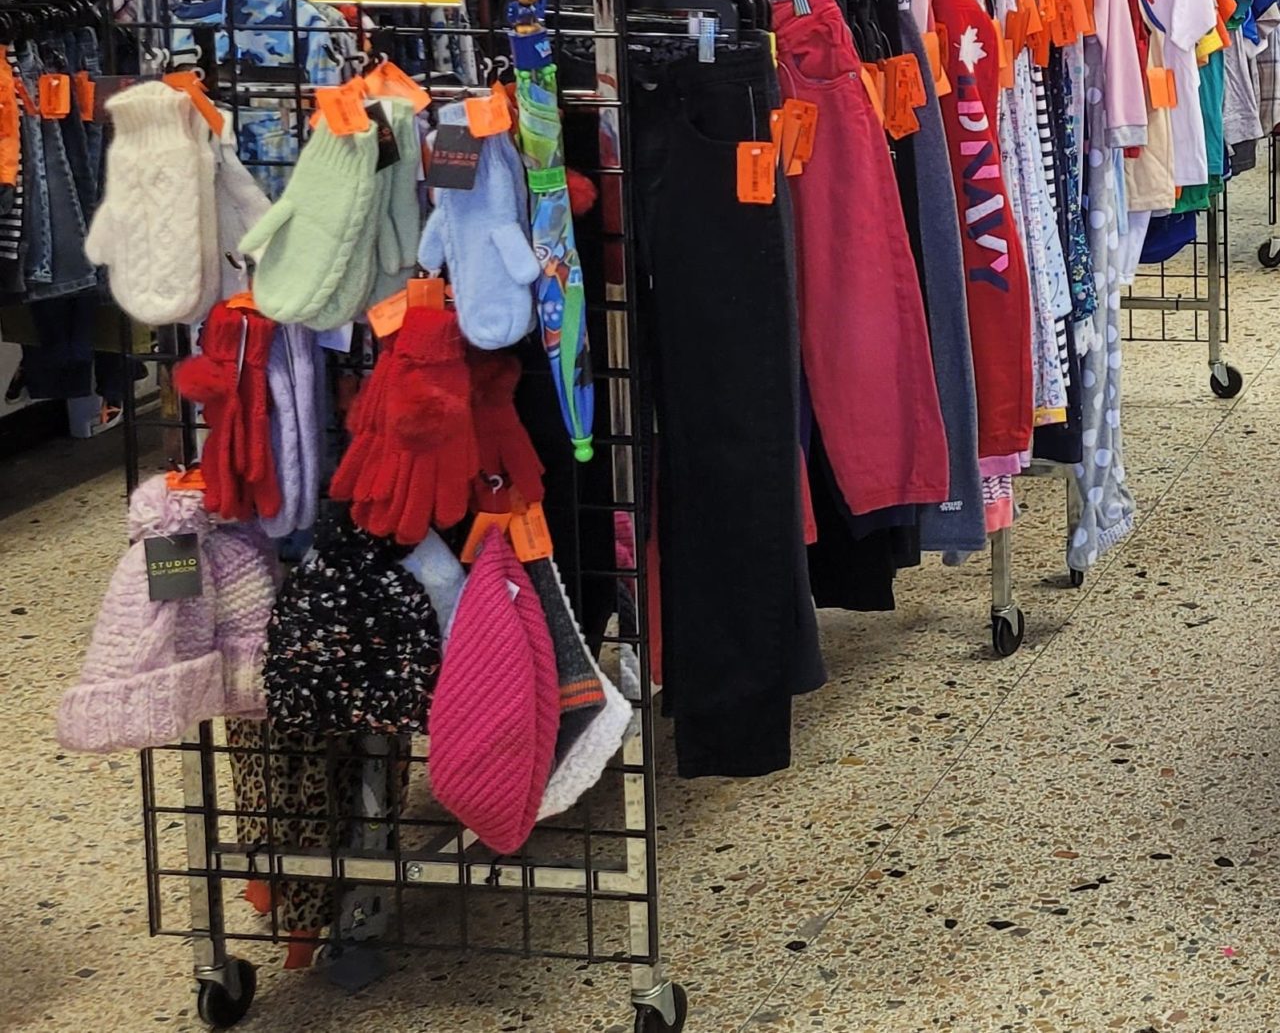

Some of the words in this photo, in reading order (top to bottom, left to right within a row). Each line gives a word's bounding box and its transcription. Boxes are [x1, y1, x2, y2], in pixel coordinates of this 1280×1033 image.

[433, 150, 479, 161] STUDIO
[959, 140, 1010, 293] NAVY
[151, 558, 197, 570] STUDIO
